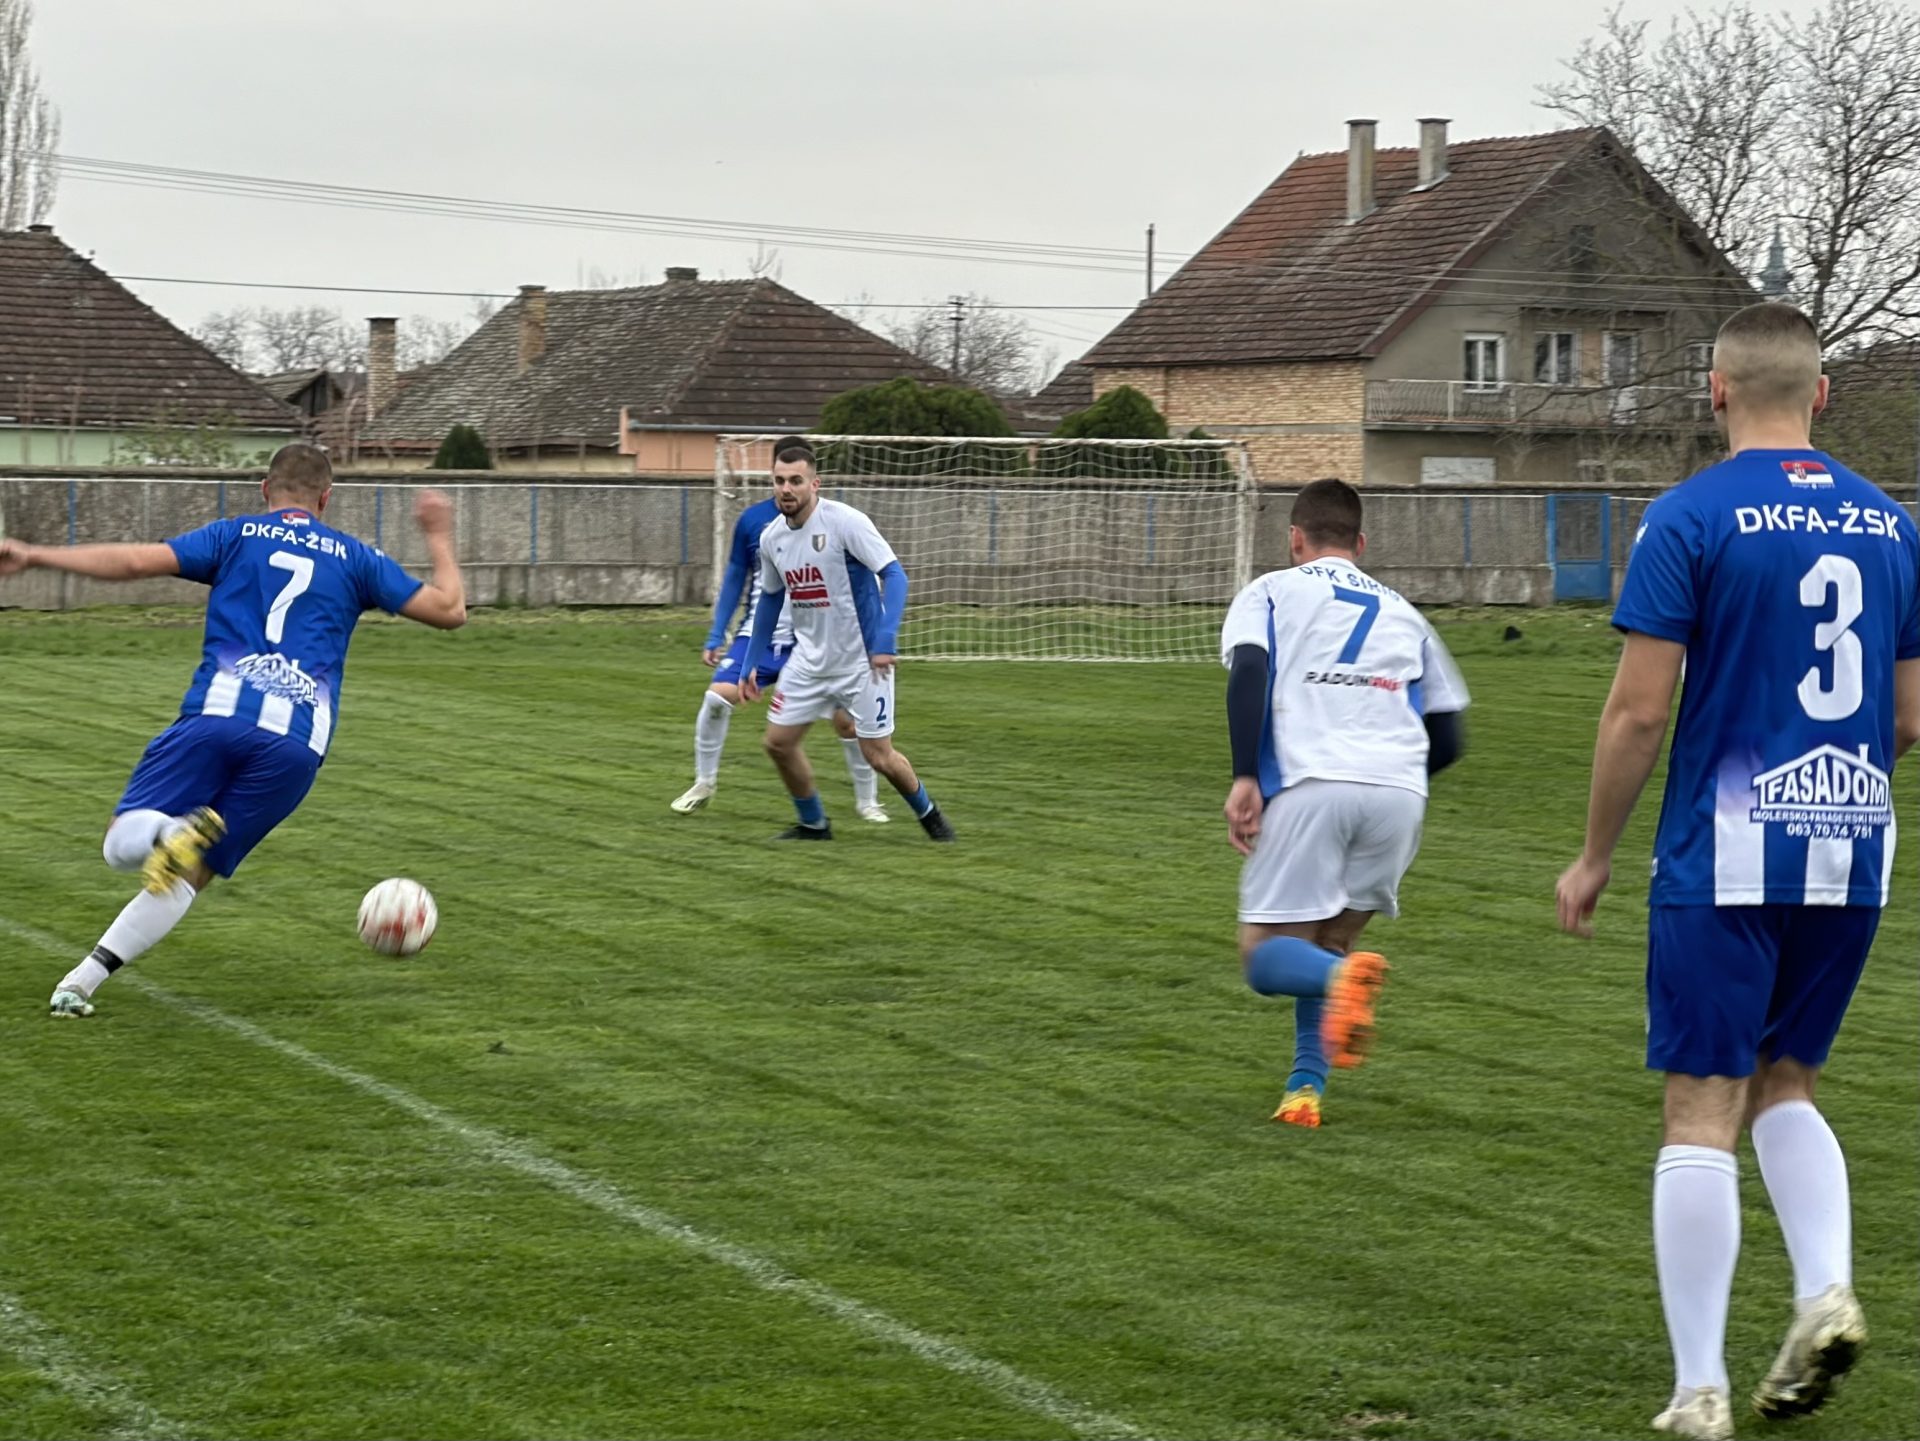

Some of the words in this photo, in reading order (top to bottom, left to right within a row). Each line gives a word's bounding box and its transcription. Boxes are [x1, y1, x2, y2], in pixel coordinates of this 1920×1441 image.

[241, 522, 347, 560] DKFA-ŽSK
[1735, 501, 1901, 542] DKFA-ŽSK
[265, 550, 315, 645] 7
[1332, 584, 1380, 664] 7
[1797, 554, 1864, 721] 3
[875, 697, 887, 722] 2
[1767, 755, 1885, 806] FASADOM
